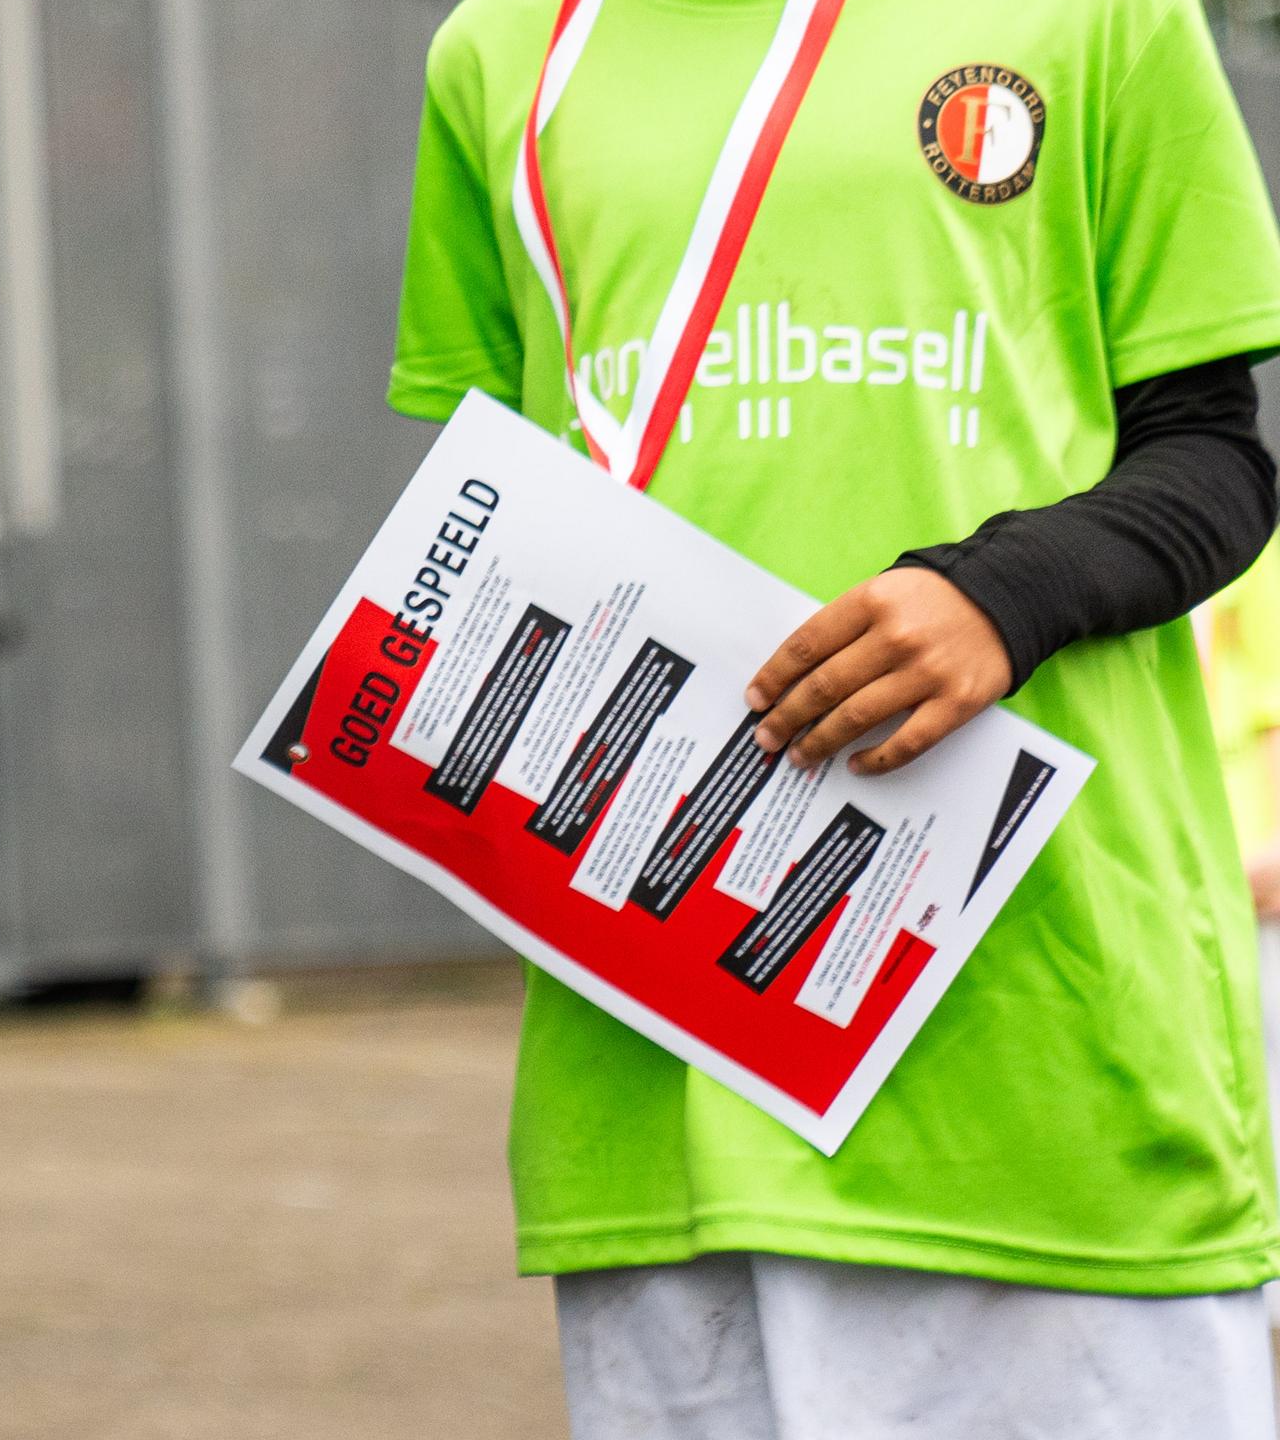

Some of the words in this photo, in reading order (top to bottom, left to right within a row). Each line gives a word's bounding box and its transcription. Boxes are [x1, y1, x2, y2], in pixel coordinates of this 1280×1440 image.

[927, 67, 1045, 125] FEYENOORD
[955, 95, 1011, 164] F
[924, 142, 1034, 203] ROTTERDAM
[329, 671, 402, 769] GOED
[380, 477, 502, 670] GESPEELD
